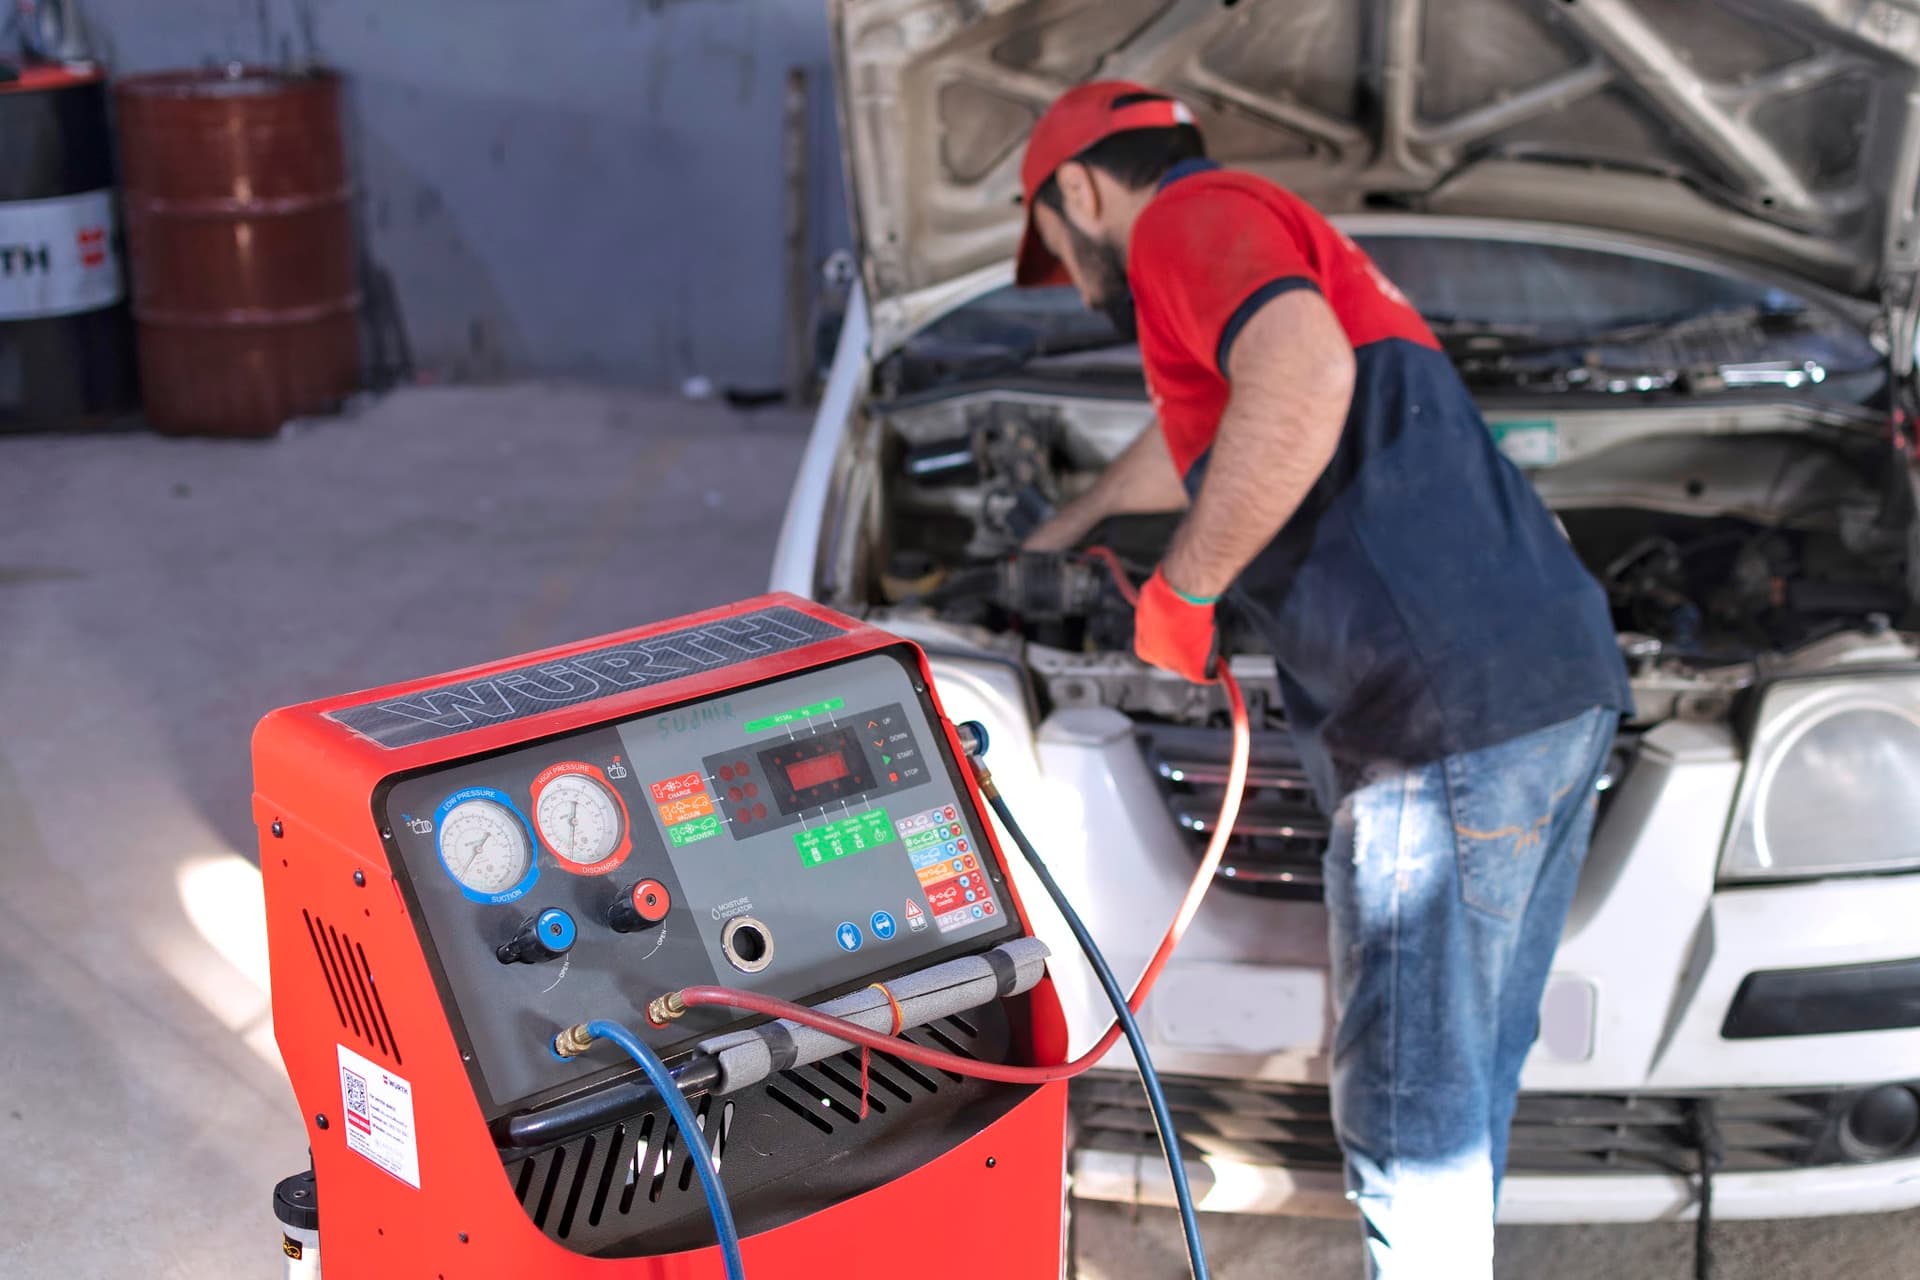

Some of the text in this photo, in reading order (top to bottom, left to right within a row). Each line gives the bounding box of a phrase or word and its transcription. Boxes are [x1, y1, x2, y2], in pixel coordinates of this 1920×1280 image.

[378, 614, 813, 728] WÜRTH
[882, 717, 891, 725] UP
[889, 733, 908, 742] DOWN
[896, 749, 914, 759] START
[538, 764, 590, 785] HIGH PRESSURE
[904, 768, 919, 777] STOP
[442, 790, 496, 812] LOW PRESSURE
[667, 788, 692, 800] CHARGE
[684, 830, 716, 843] RECOVERY
[582, 858, 620, 875] DISCHARGE
[491, 888, 522, 903] SUCTION
[718, 896, 749, 912] MOISTURE
[720, 903, 753, 919] INDICATOR
[656, 929, 667, 947] OPEN
[559, 961, 570, 979] OPEN
